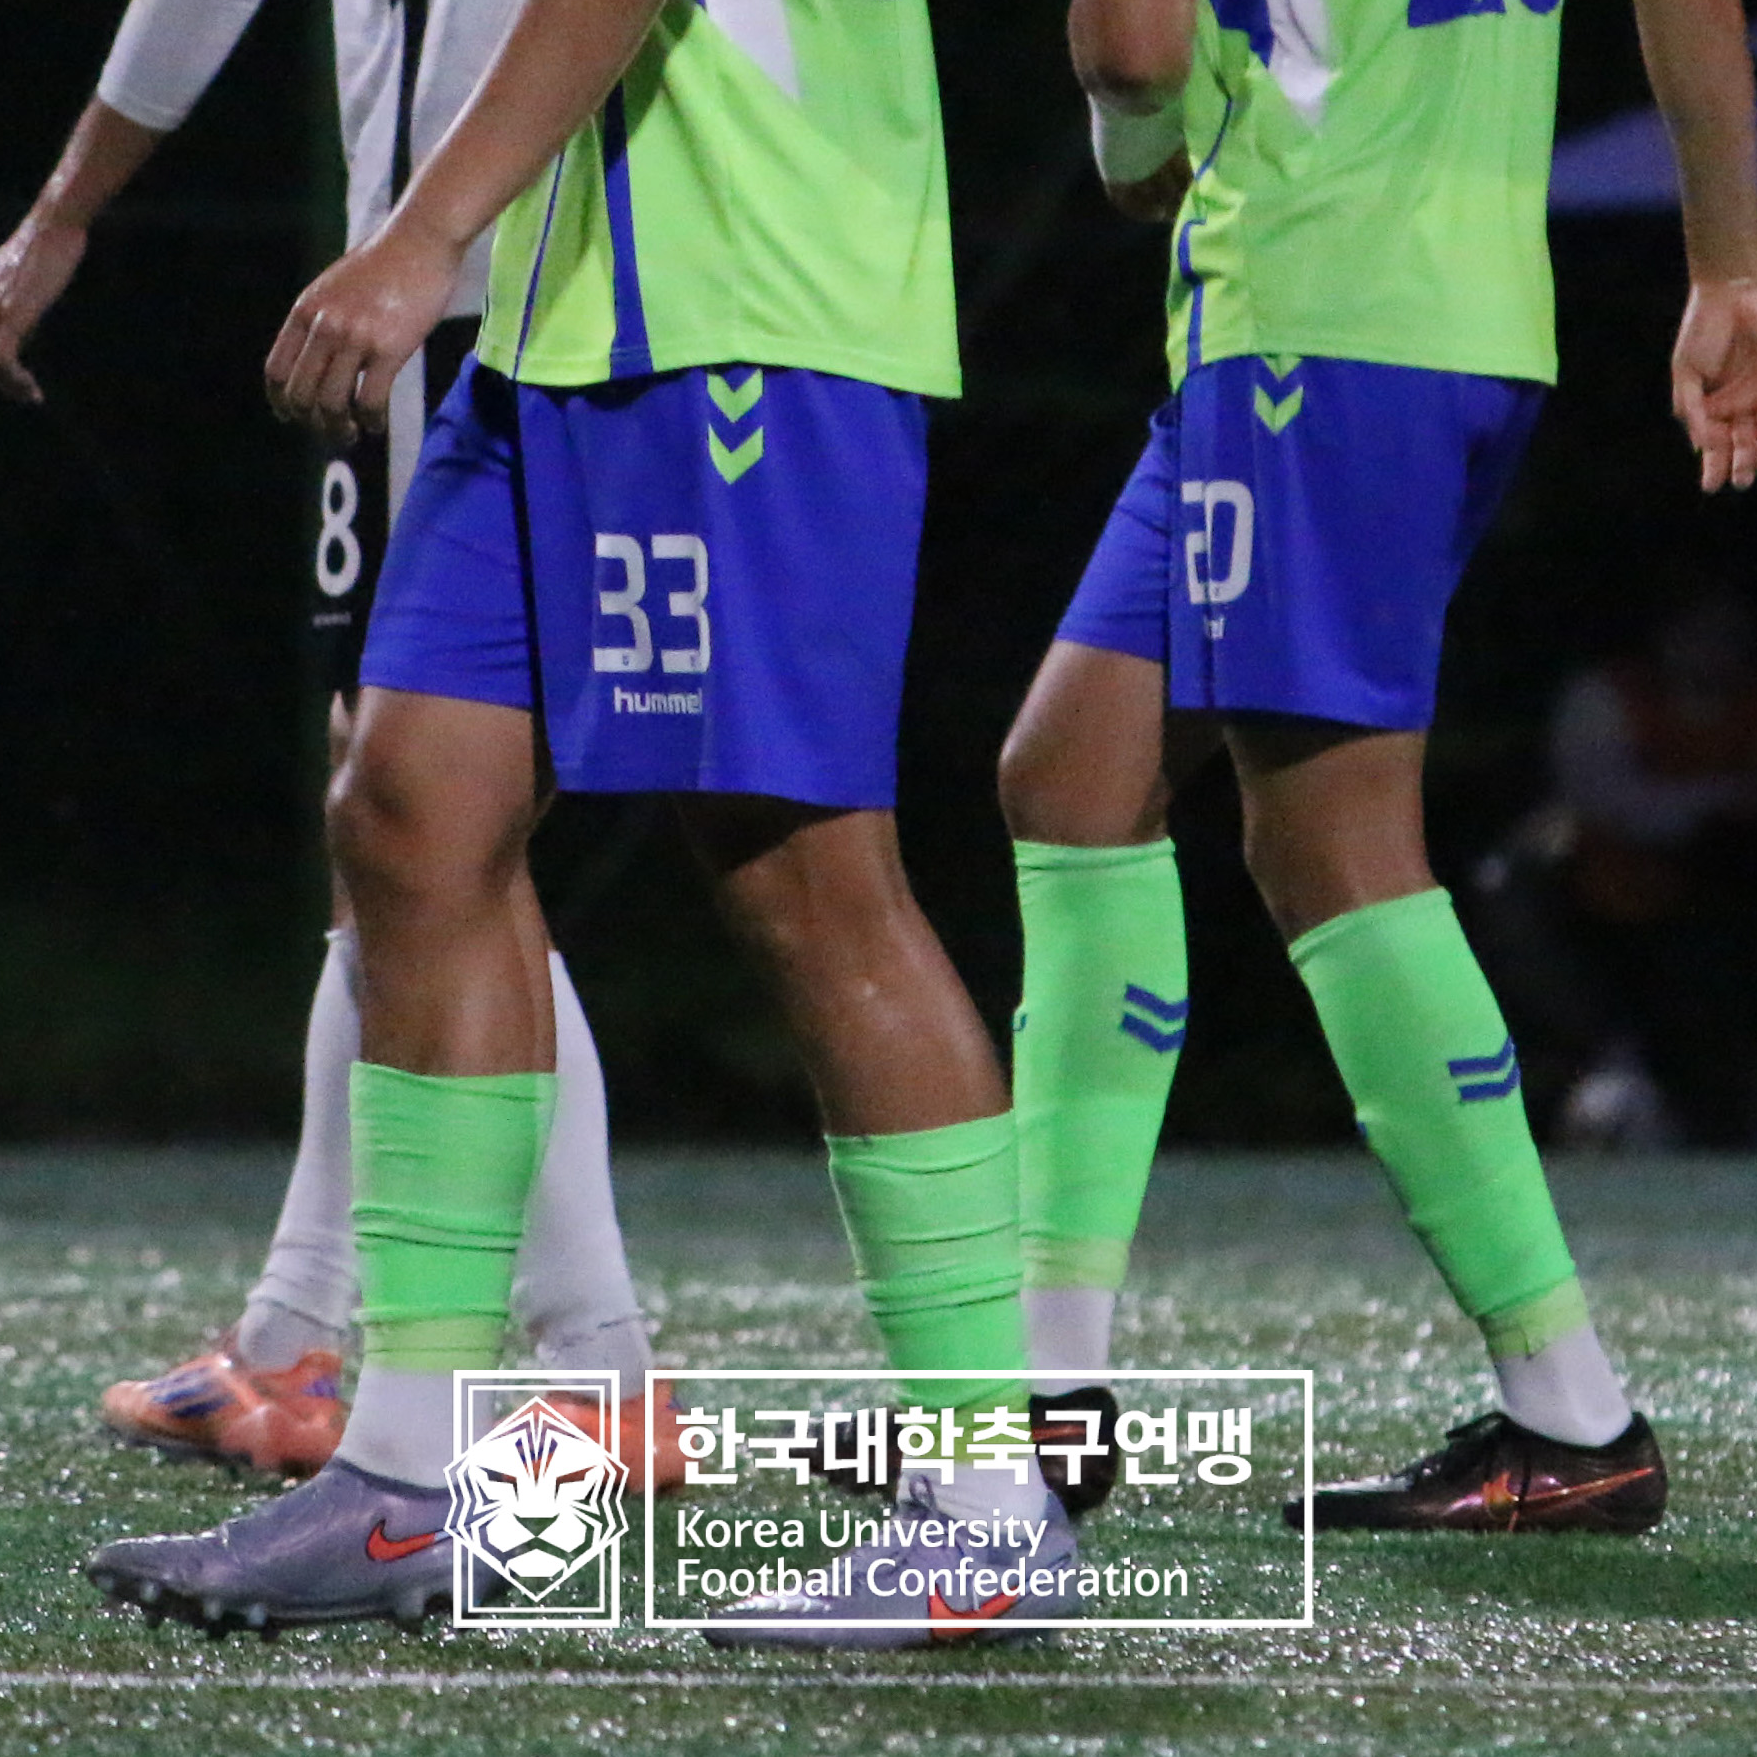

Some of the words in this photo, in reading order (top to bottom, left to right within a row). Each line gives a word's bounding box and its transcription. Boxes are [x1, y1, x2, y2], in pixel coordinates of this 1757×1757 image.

[593, 532, 711, 674] 33
[1181, 479, 1256, 606] 20
[613, 685, 703, 715] hummel
